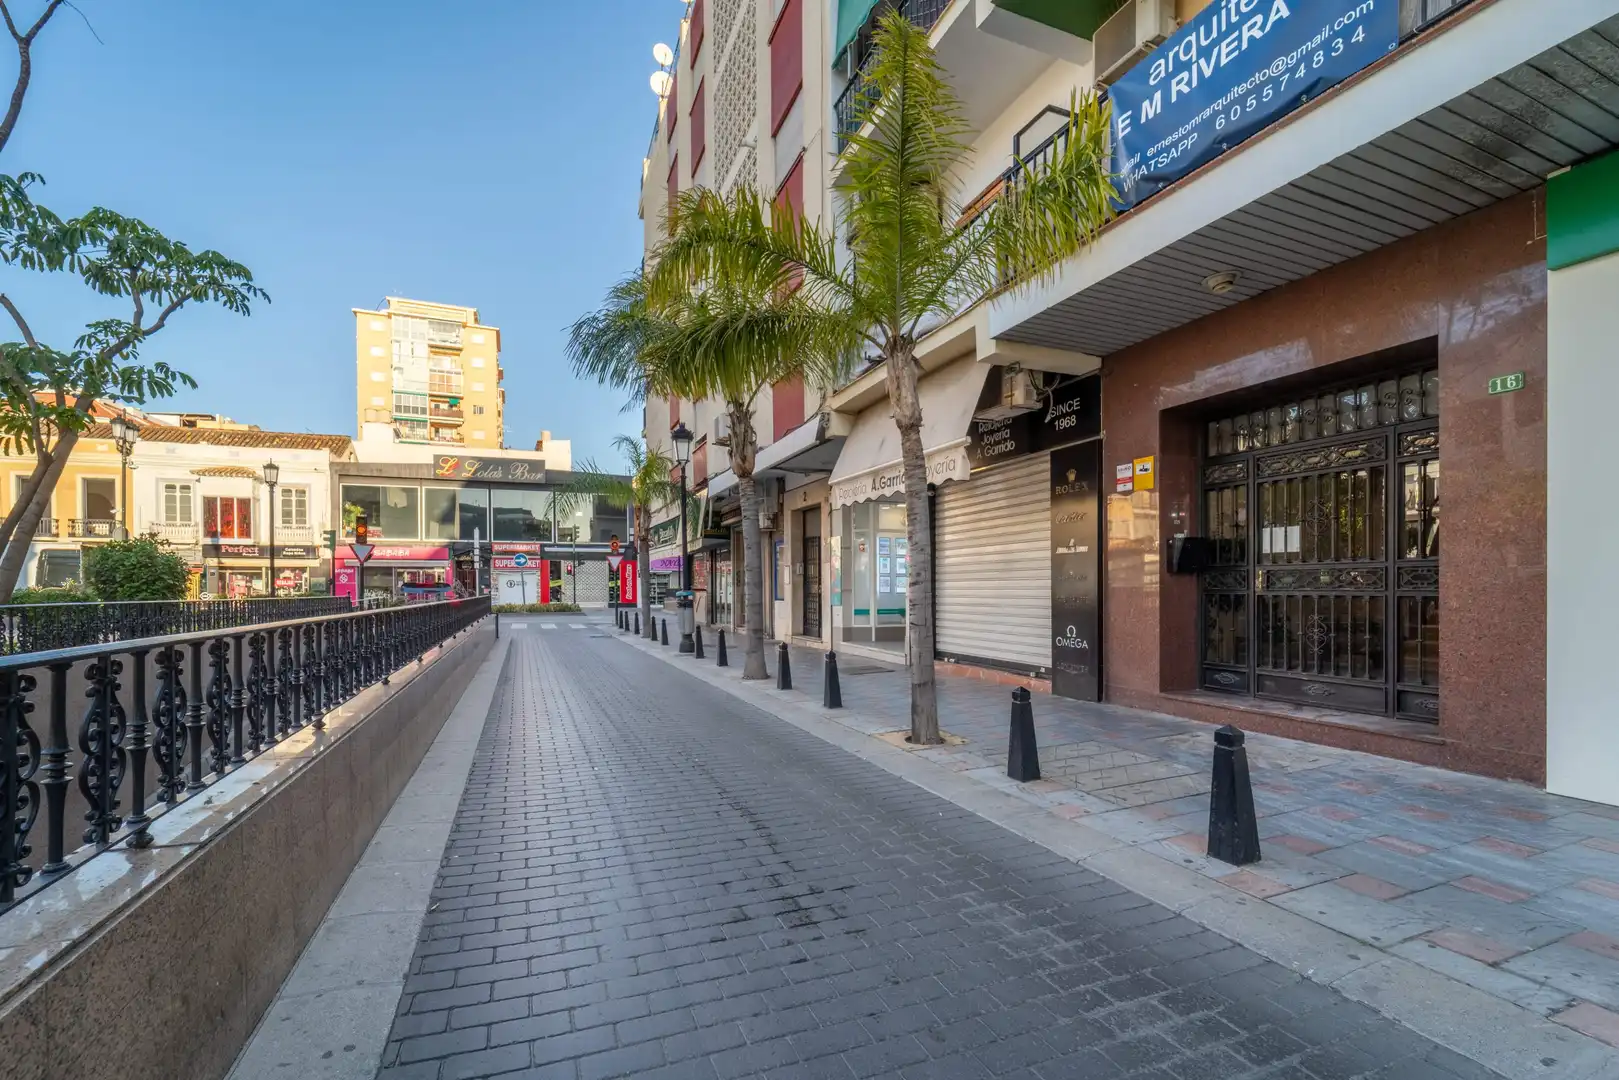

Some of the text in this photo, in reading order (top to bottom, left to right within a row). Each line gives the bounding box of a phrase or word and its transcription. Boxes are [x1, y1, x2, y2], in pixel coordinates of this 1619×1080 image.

[1118, 0, 1290, 140] E M RIVERA
[1147, 0, 1374, 156] ernestomrarquitecto@gmail.com
[1123, 133, 1198, 193] WHATSAPP
[1495, 375, 1516, 391] 16
[1050, 398, 1080, 418] SINCE
[1055, 415, 1076, 431] 1968
[985, 441, 1015, 456] Garrido
[462, 460, 503, 478] Lola's
[508, 462, 544, 480] Bar
[925, 456, 956, 477] oyería
[1055, 481, 1088, 495] ROLEX
[221, 545, 259, 553] Perfect
[1055, 636, 1088, 650] OMEGA
